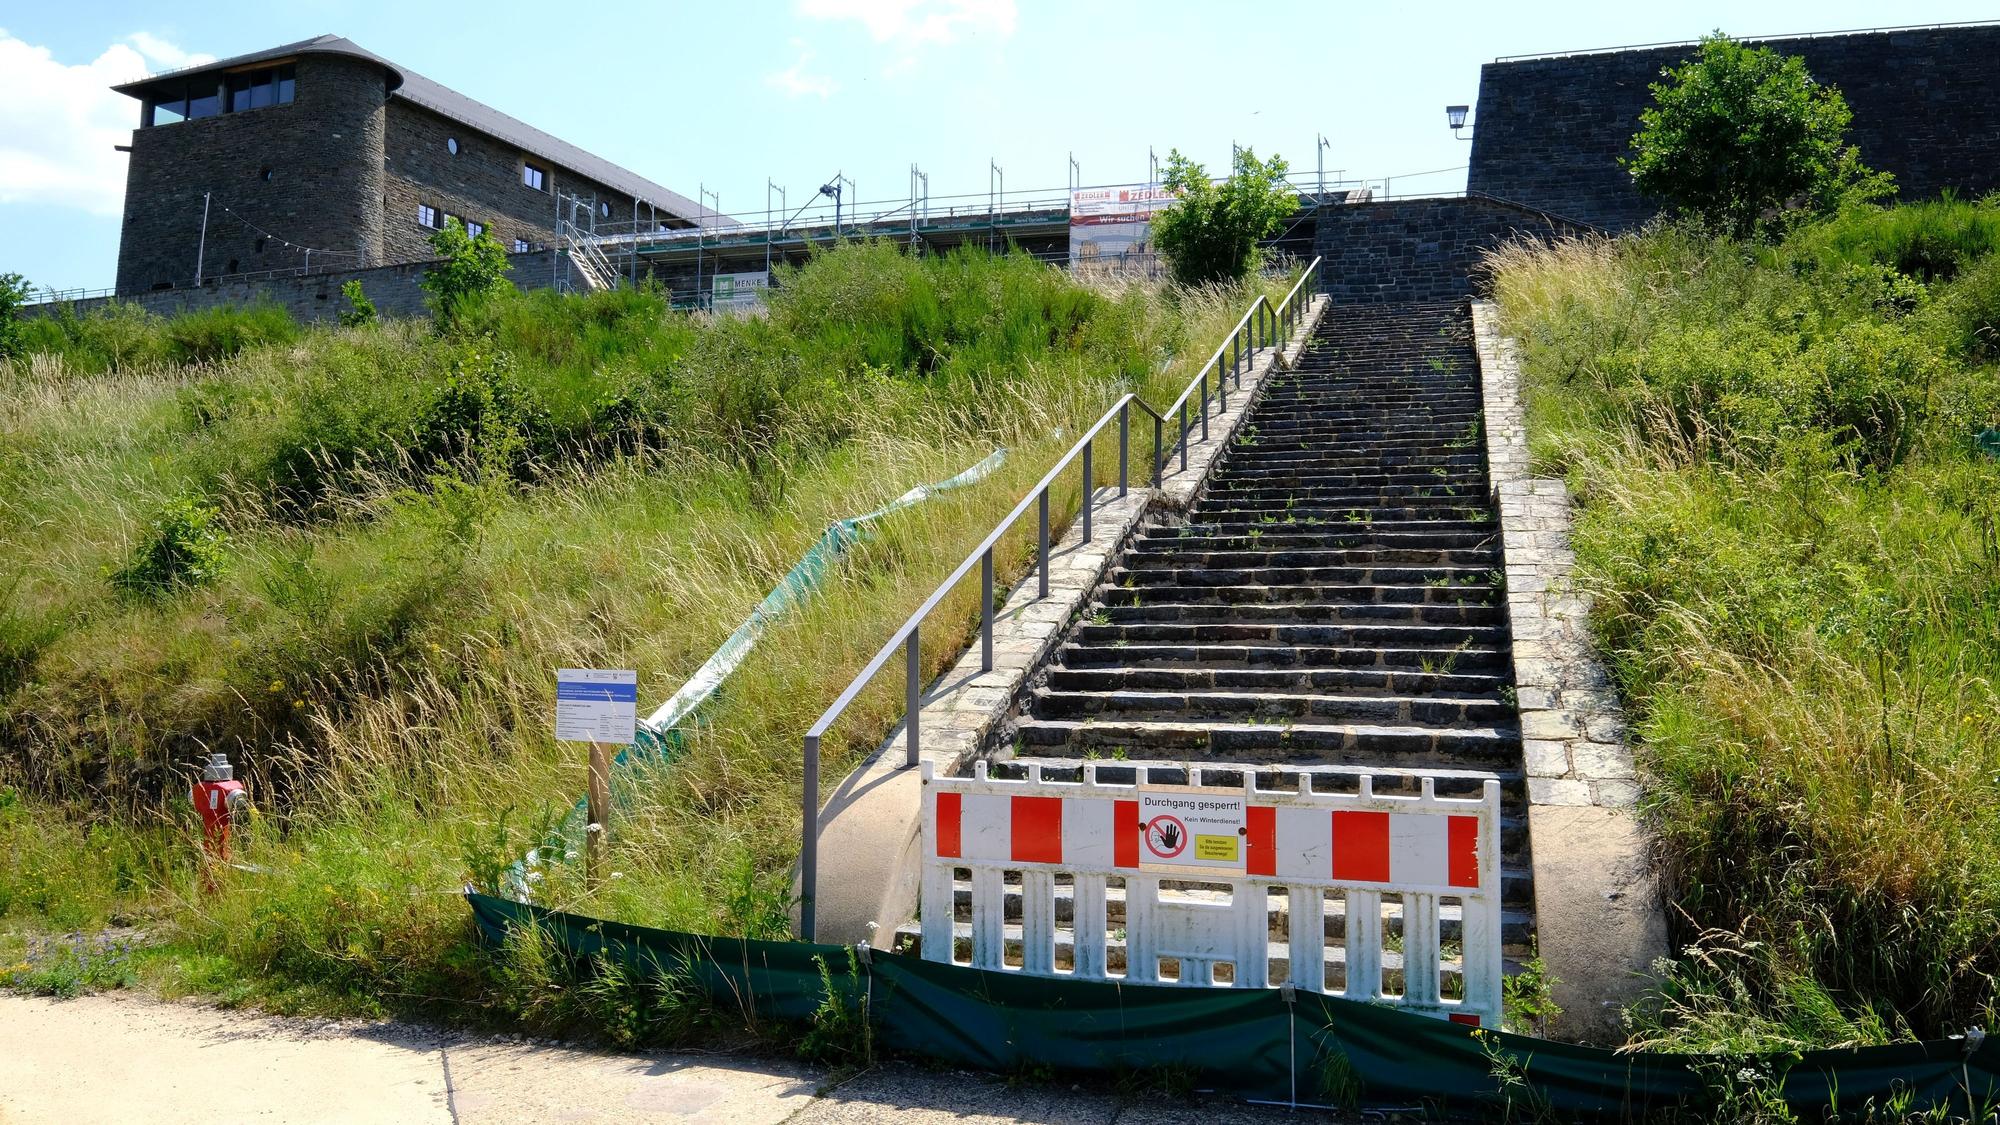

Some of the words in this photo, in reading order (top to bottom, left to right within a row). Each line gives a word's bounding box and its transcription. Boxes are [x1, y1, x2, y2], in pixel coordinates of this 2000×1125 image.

[1131, 187, 1173, 201] ZEDLER
[1144, 797, 1196, 810] Durchgang
[1198, 801, 1241, 811] gesperrt!
[1199, 817, 1241, 825] Winterdienst!
